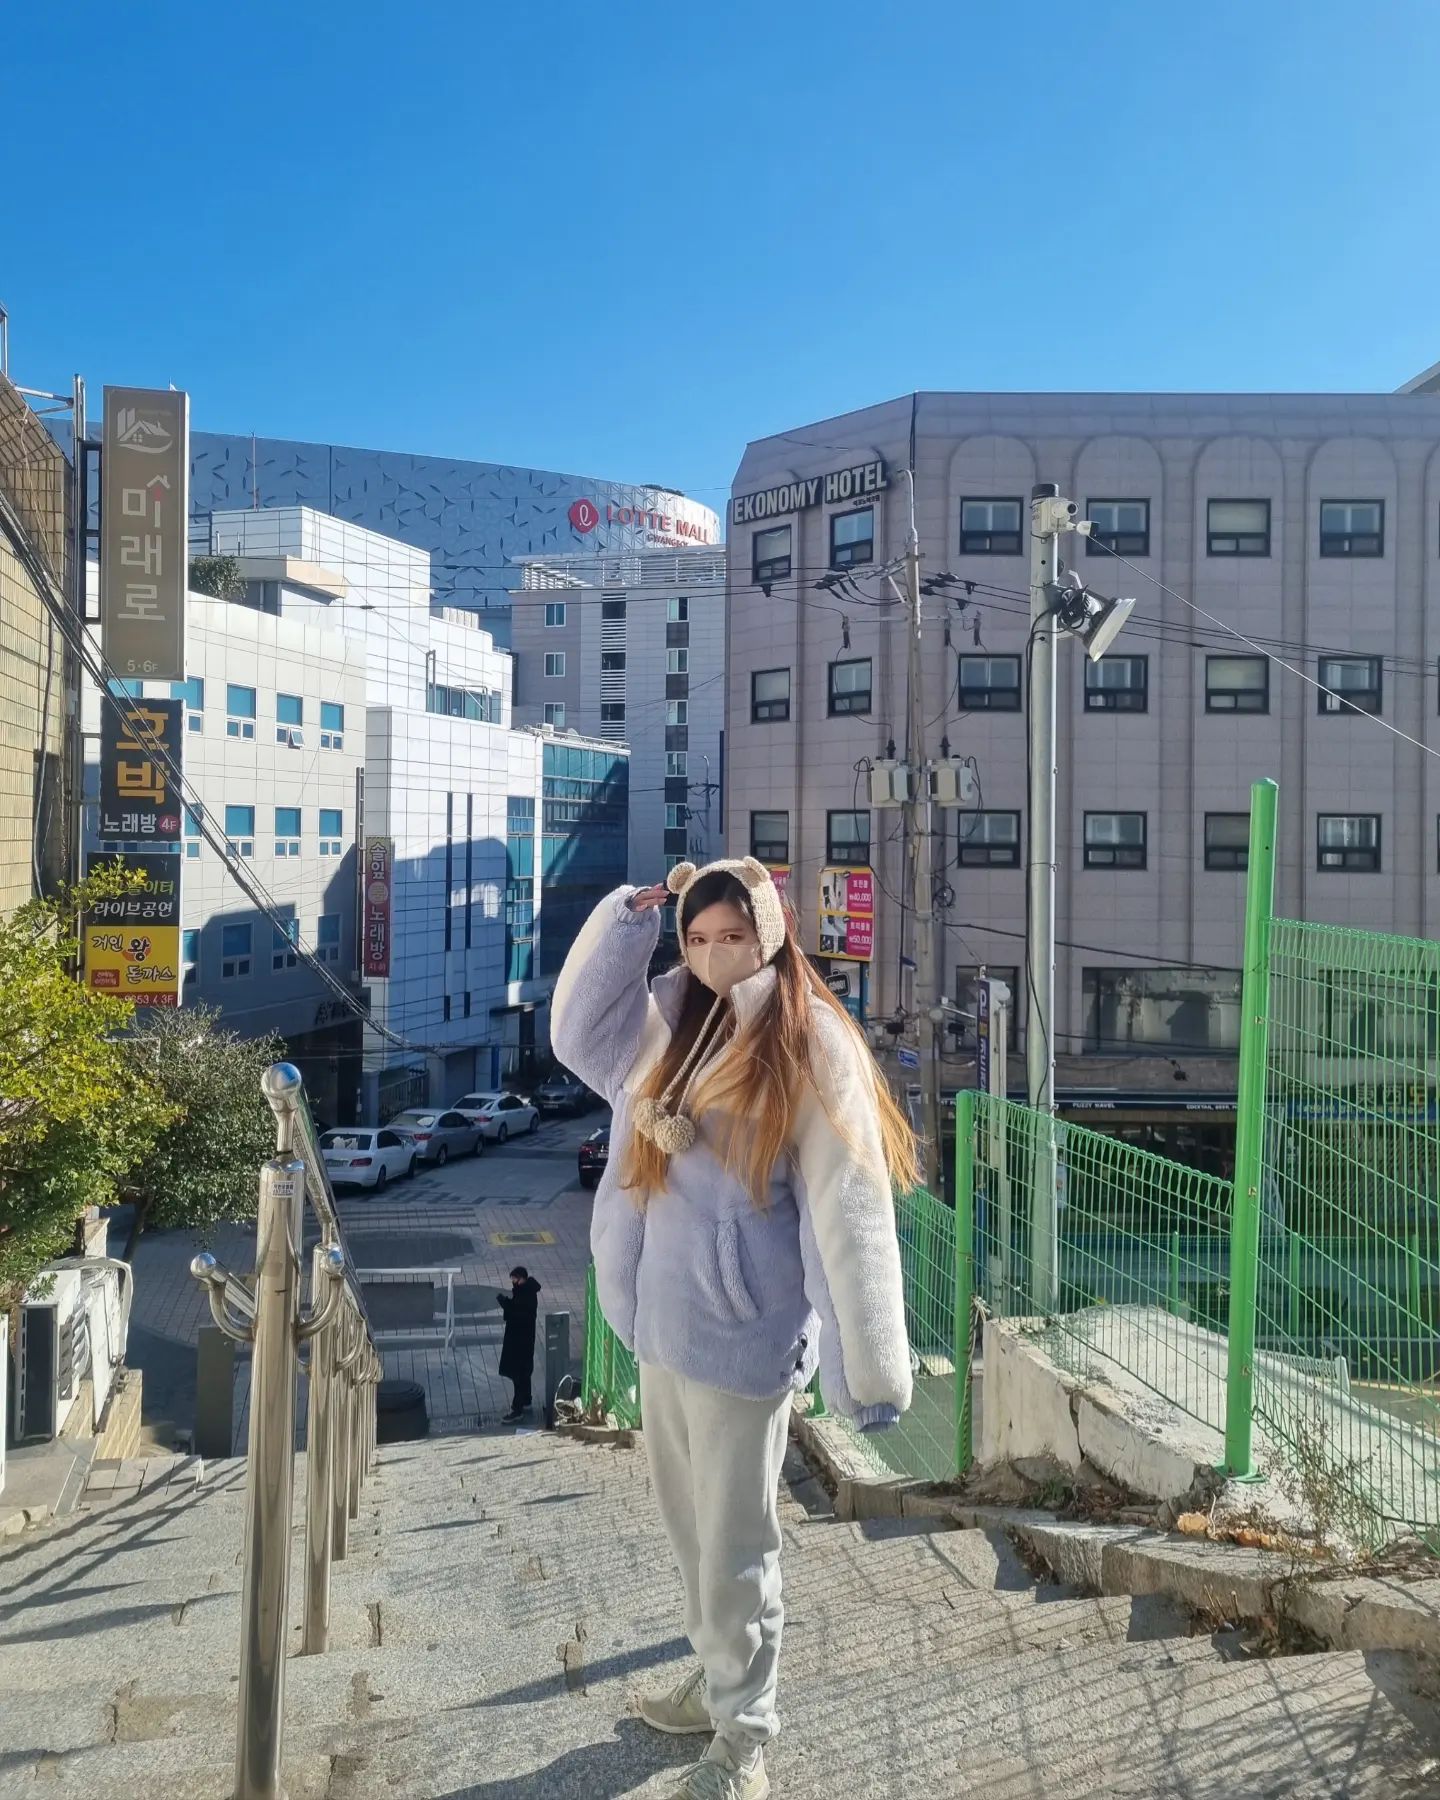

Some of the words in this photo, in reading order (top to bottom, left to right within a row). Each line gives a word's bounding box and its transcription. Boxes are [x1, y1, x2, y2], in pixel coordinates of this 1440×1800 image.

[733, 480, 819, 524] EKONOMY
[825, 461, 887, 501] HOTEL
[606, 504, 672, 533] LOTTE
[675, 519, 711, 545] MALL
[117, 474, 171, 621] 미래로
[103, 813, 157, 834] 노래방
[161, 818, 178, 831] 4F
[370, 841, 387, 880] 솔잎
[94, 901, 174, 918] 라이브공연
[91, 934, 124, 953] 거인
[127, 936, 151, 963] 왕
[369, 905, 386, 961] 노래방
[126, 964, 176, 985] 돈까스
[161, 994, 174, 1005] 3F
